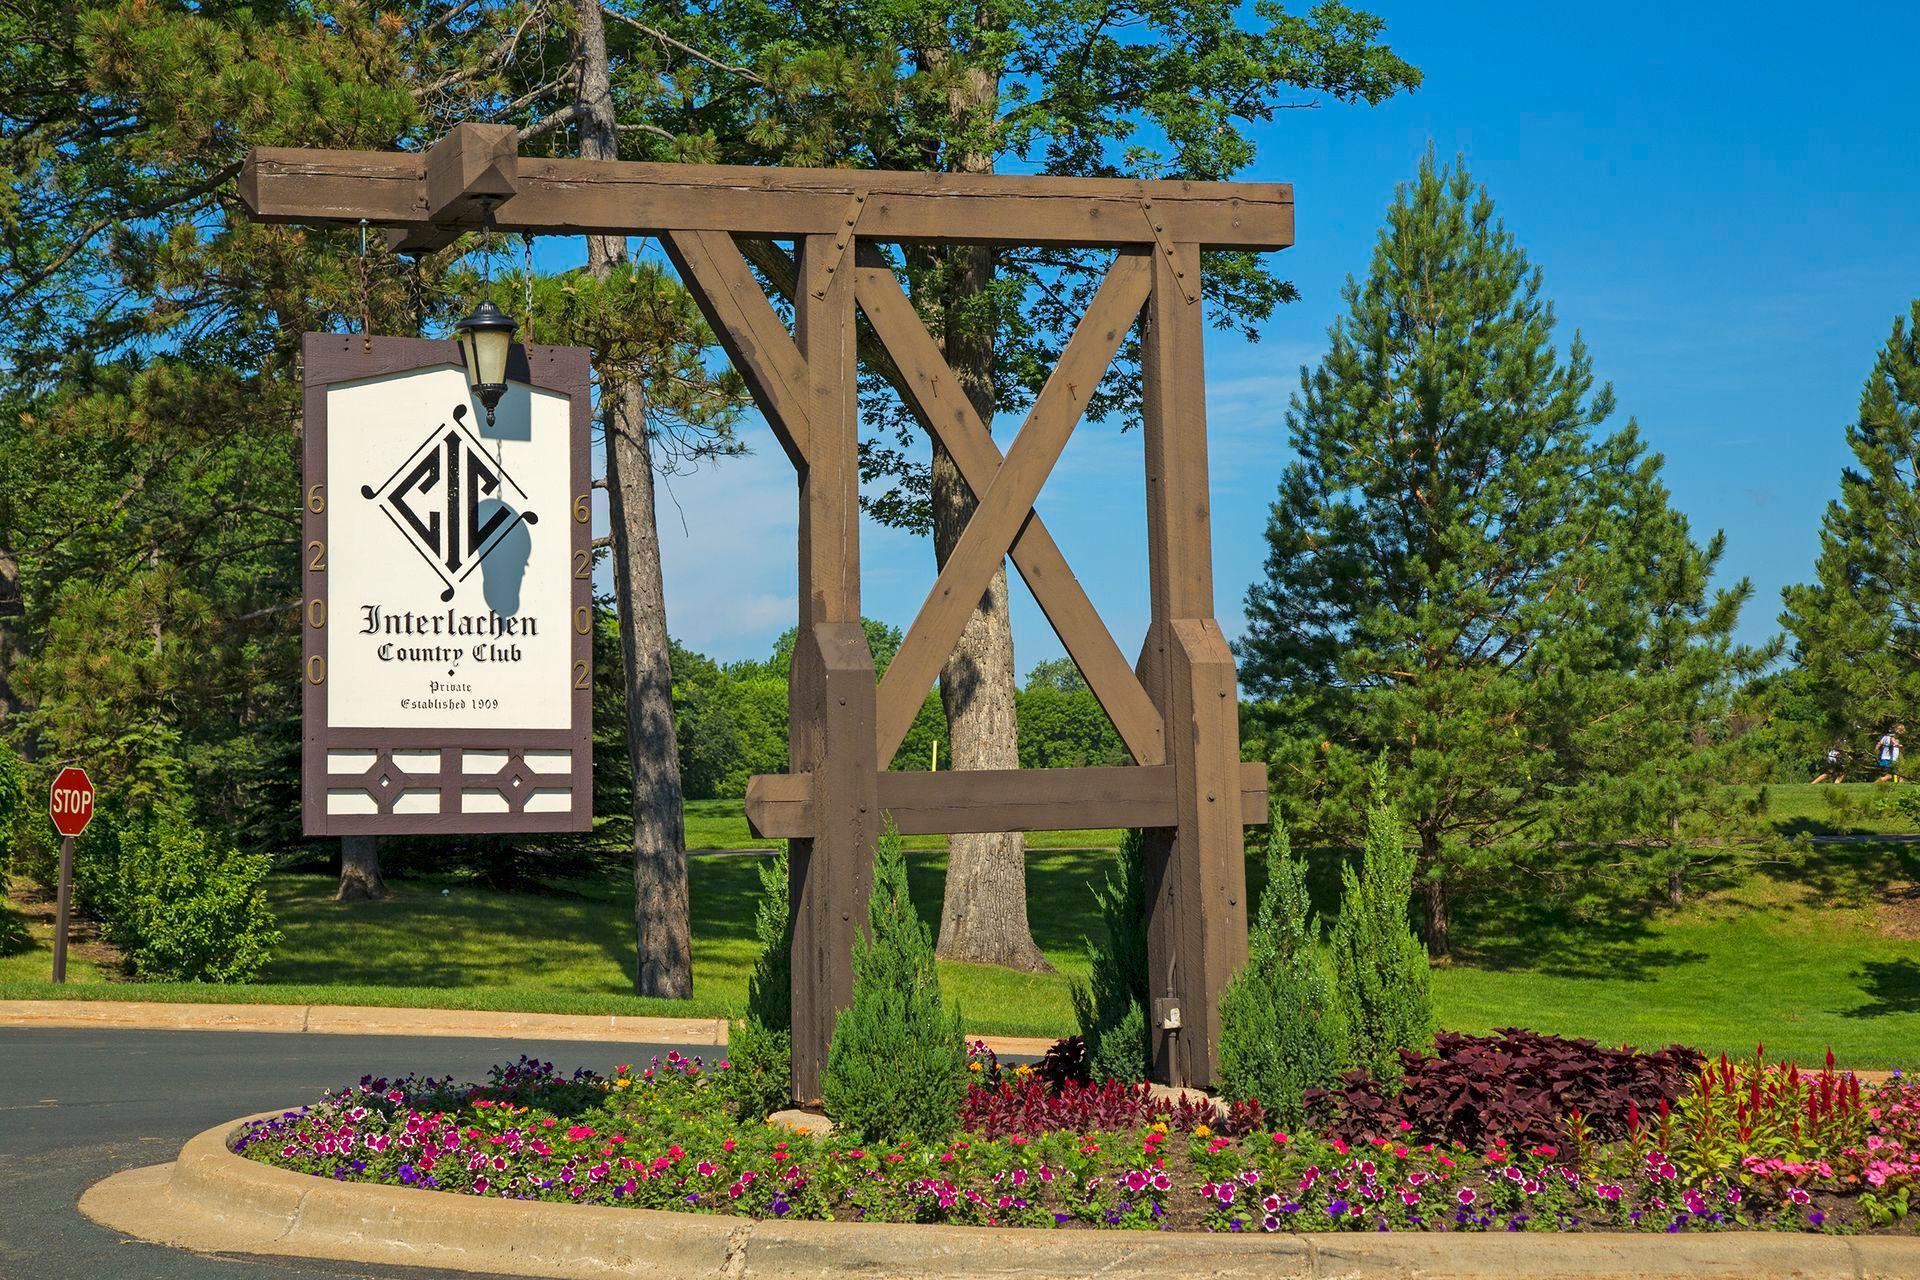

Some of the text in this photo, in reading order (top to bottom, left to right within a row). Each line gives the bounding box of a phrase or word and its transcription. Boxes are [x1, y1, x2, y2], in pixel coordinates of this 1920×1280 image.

[359, 604, 539, 639] Interlachen
[377, 642, 522, 667] Country Club
[429, 680, 472, 693] Private
[400, 698, 499, 710] Established 1909
[53, 788, 91, 814] STOP
